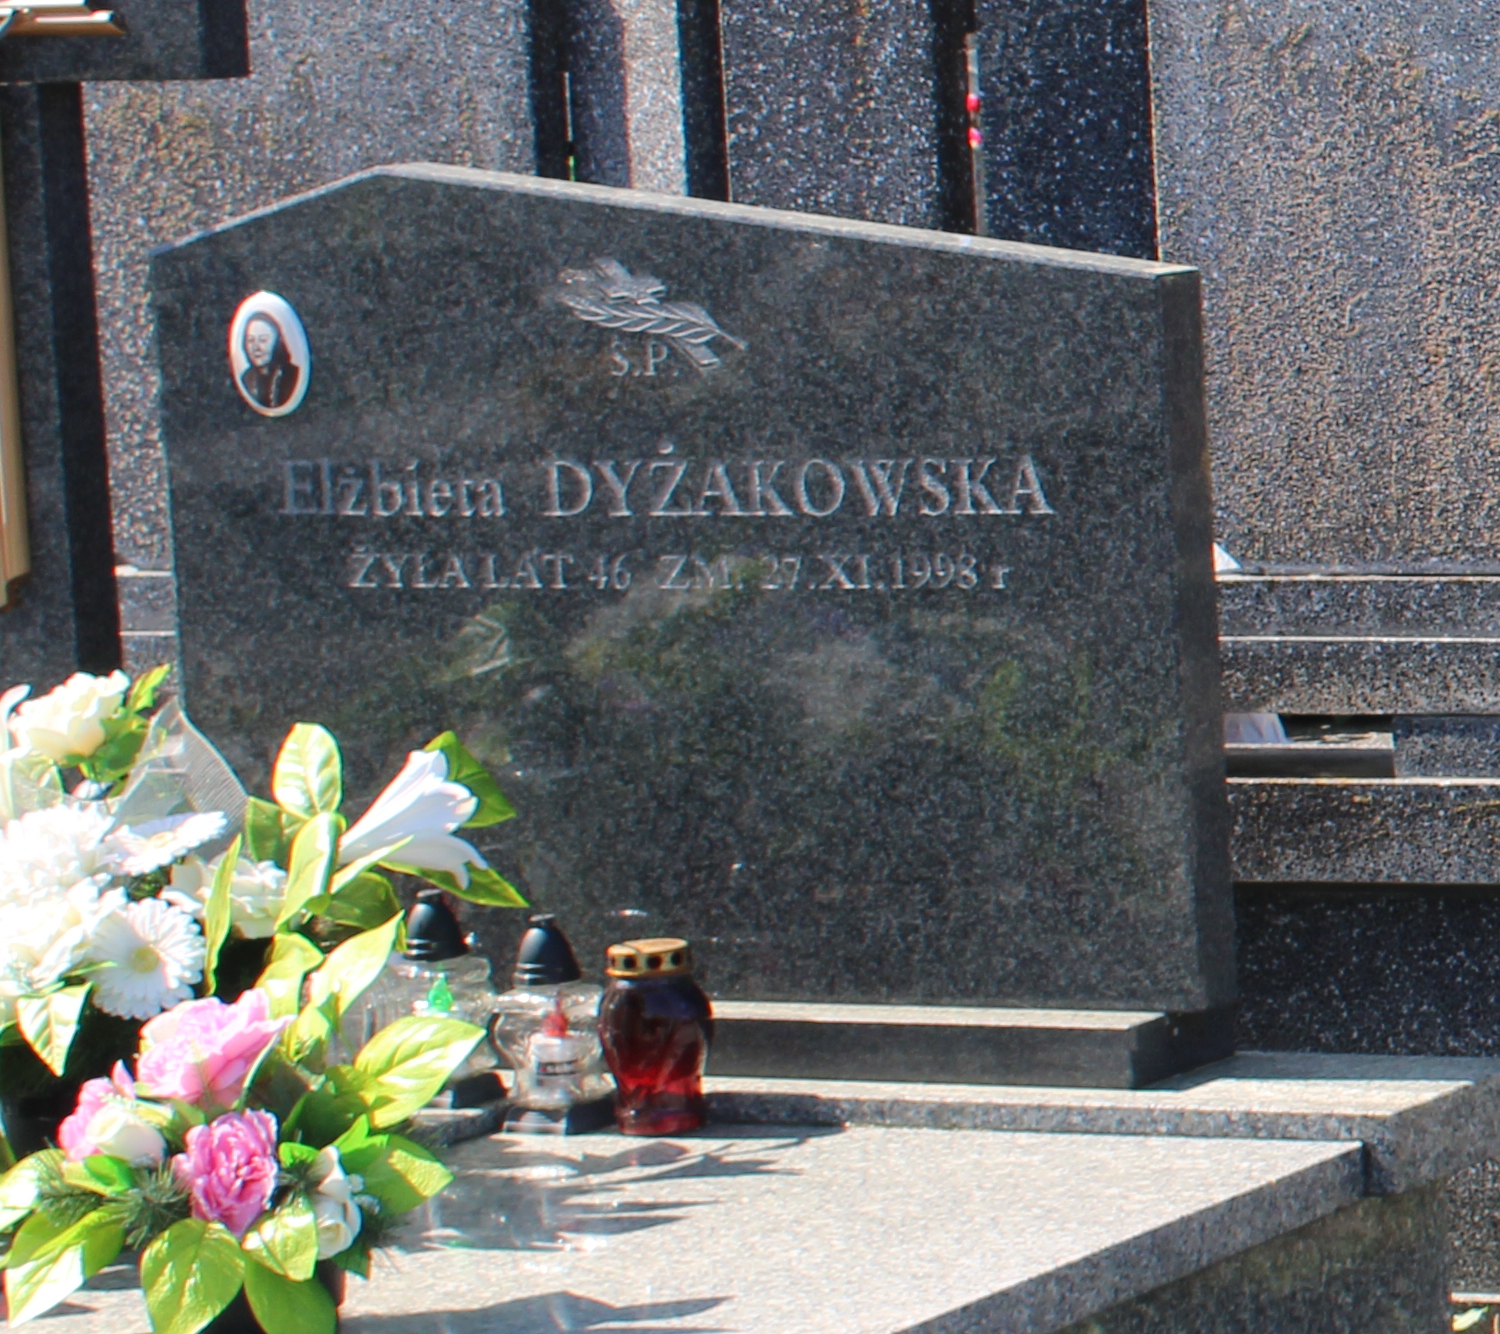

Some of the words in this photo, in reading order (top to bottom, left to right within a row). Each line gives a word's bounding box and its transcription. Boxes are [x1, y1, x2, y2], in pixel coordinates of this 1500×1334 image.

[276, 457, 506, 518] Elżbieta
[541, 440, 1057, 518] DYŻAKOWSKA
[482, 551, 575, 590] LAT
